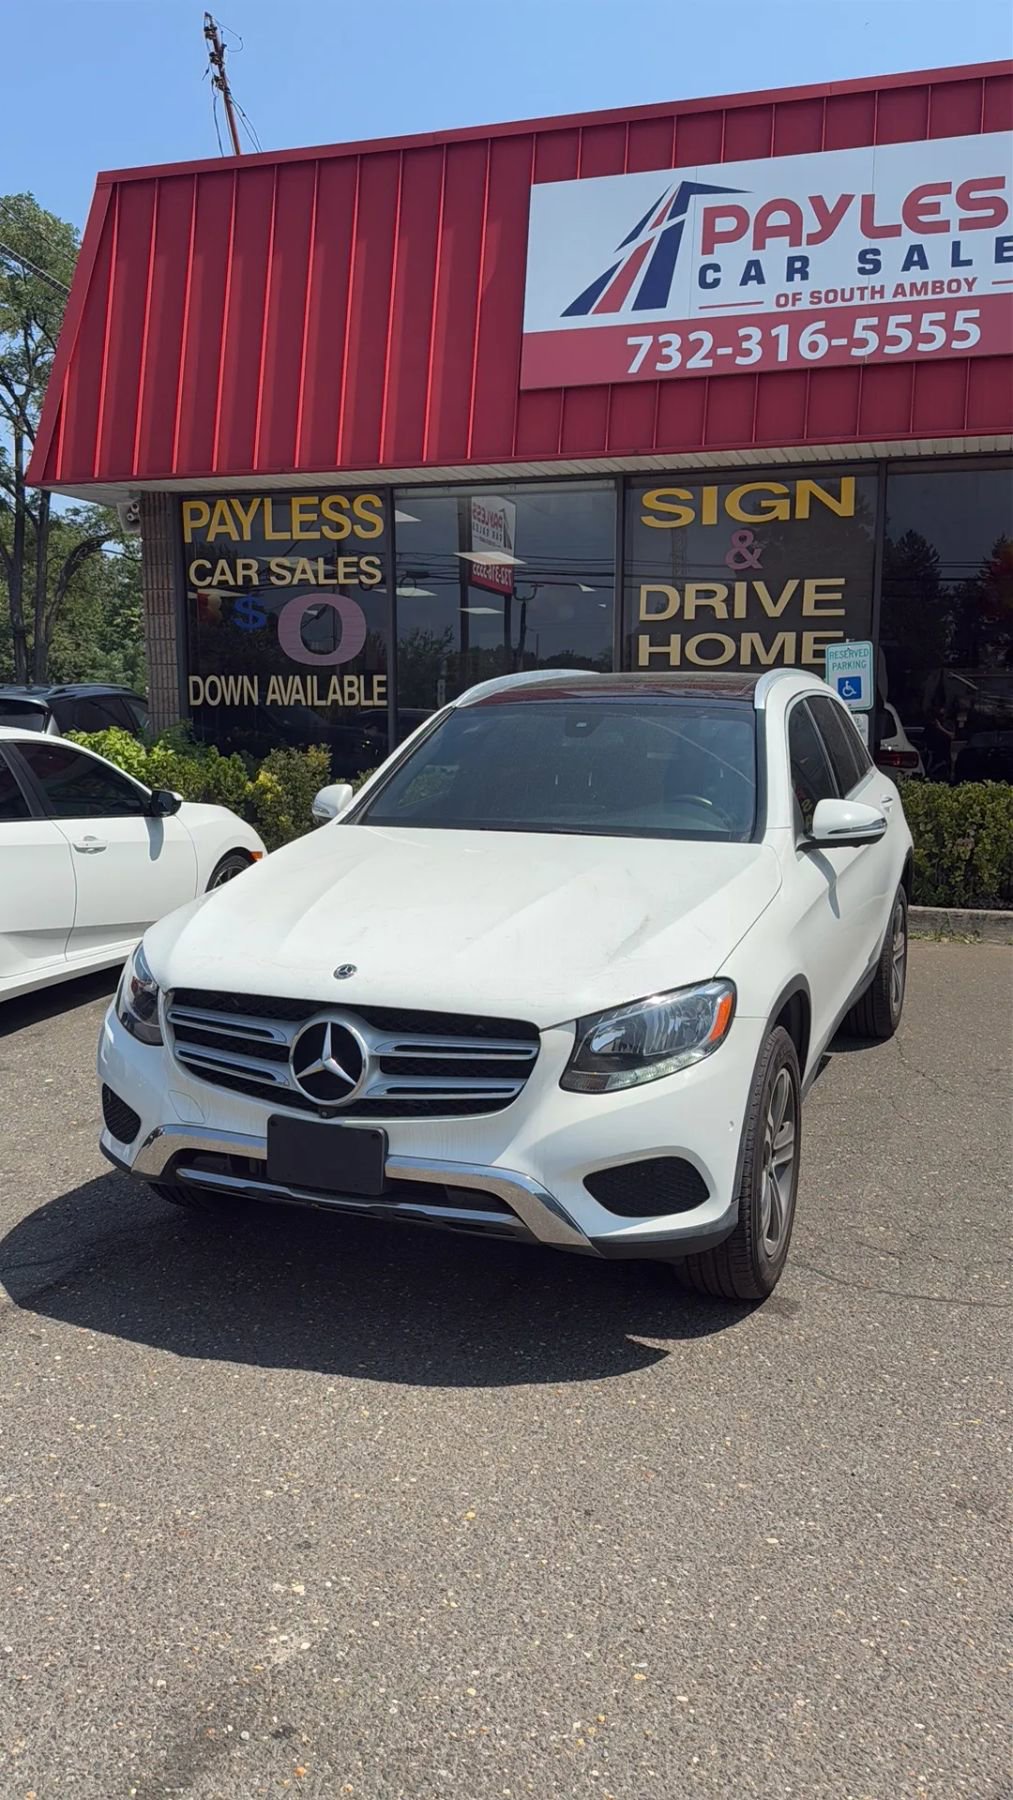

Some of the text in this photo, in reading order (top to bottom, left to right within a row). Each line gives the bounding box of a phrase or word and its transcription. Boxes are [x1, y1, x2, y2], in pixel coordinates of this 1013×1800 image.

[698, 255, 810, 289] CAR
[775, 277, 978, 308] OF SOUTH AMBOY
[626, 309, 981, 374] 732-316-5555
[182, 494, 385, 543] PAYLESS
[640, 476, 855, 529] SIGN
[724, 529, 763, 571] &
[188, 556, 382, 587] CAR SALES
[639, 578, 846, 621] DRIVE
[638, 630, 844, 666] HOME
[829, 648, 869, 661] RESERVED
[832, 660, 866, 672] PARKING
[188, 674, 387, 707] DOWN AVAILABLE
